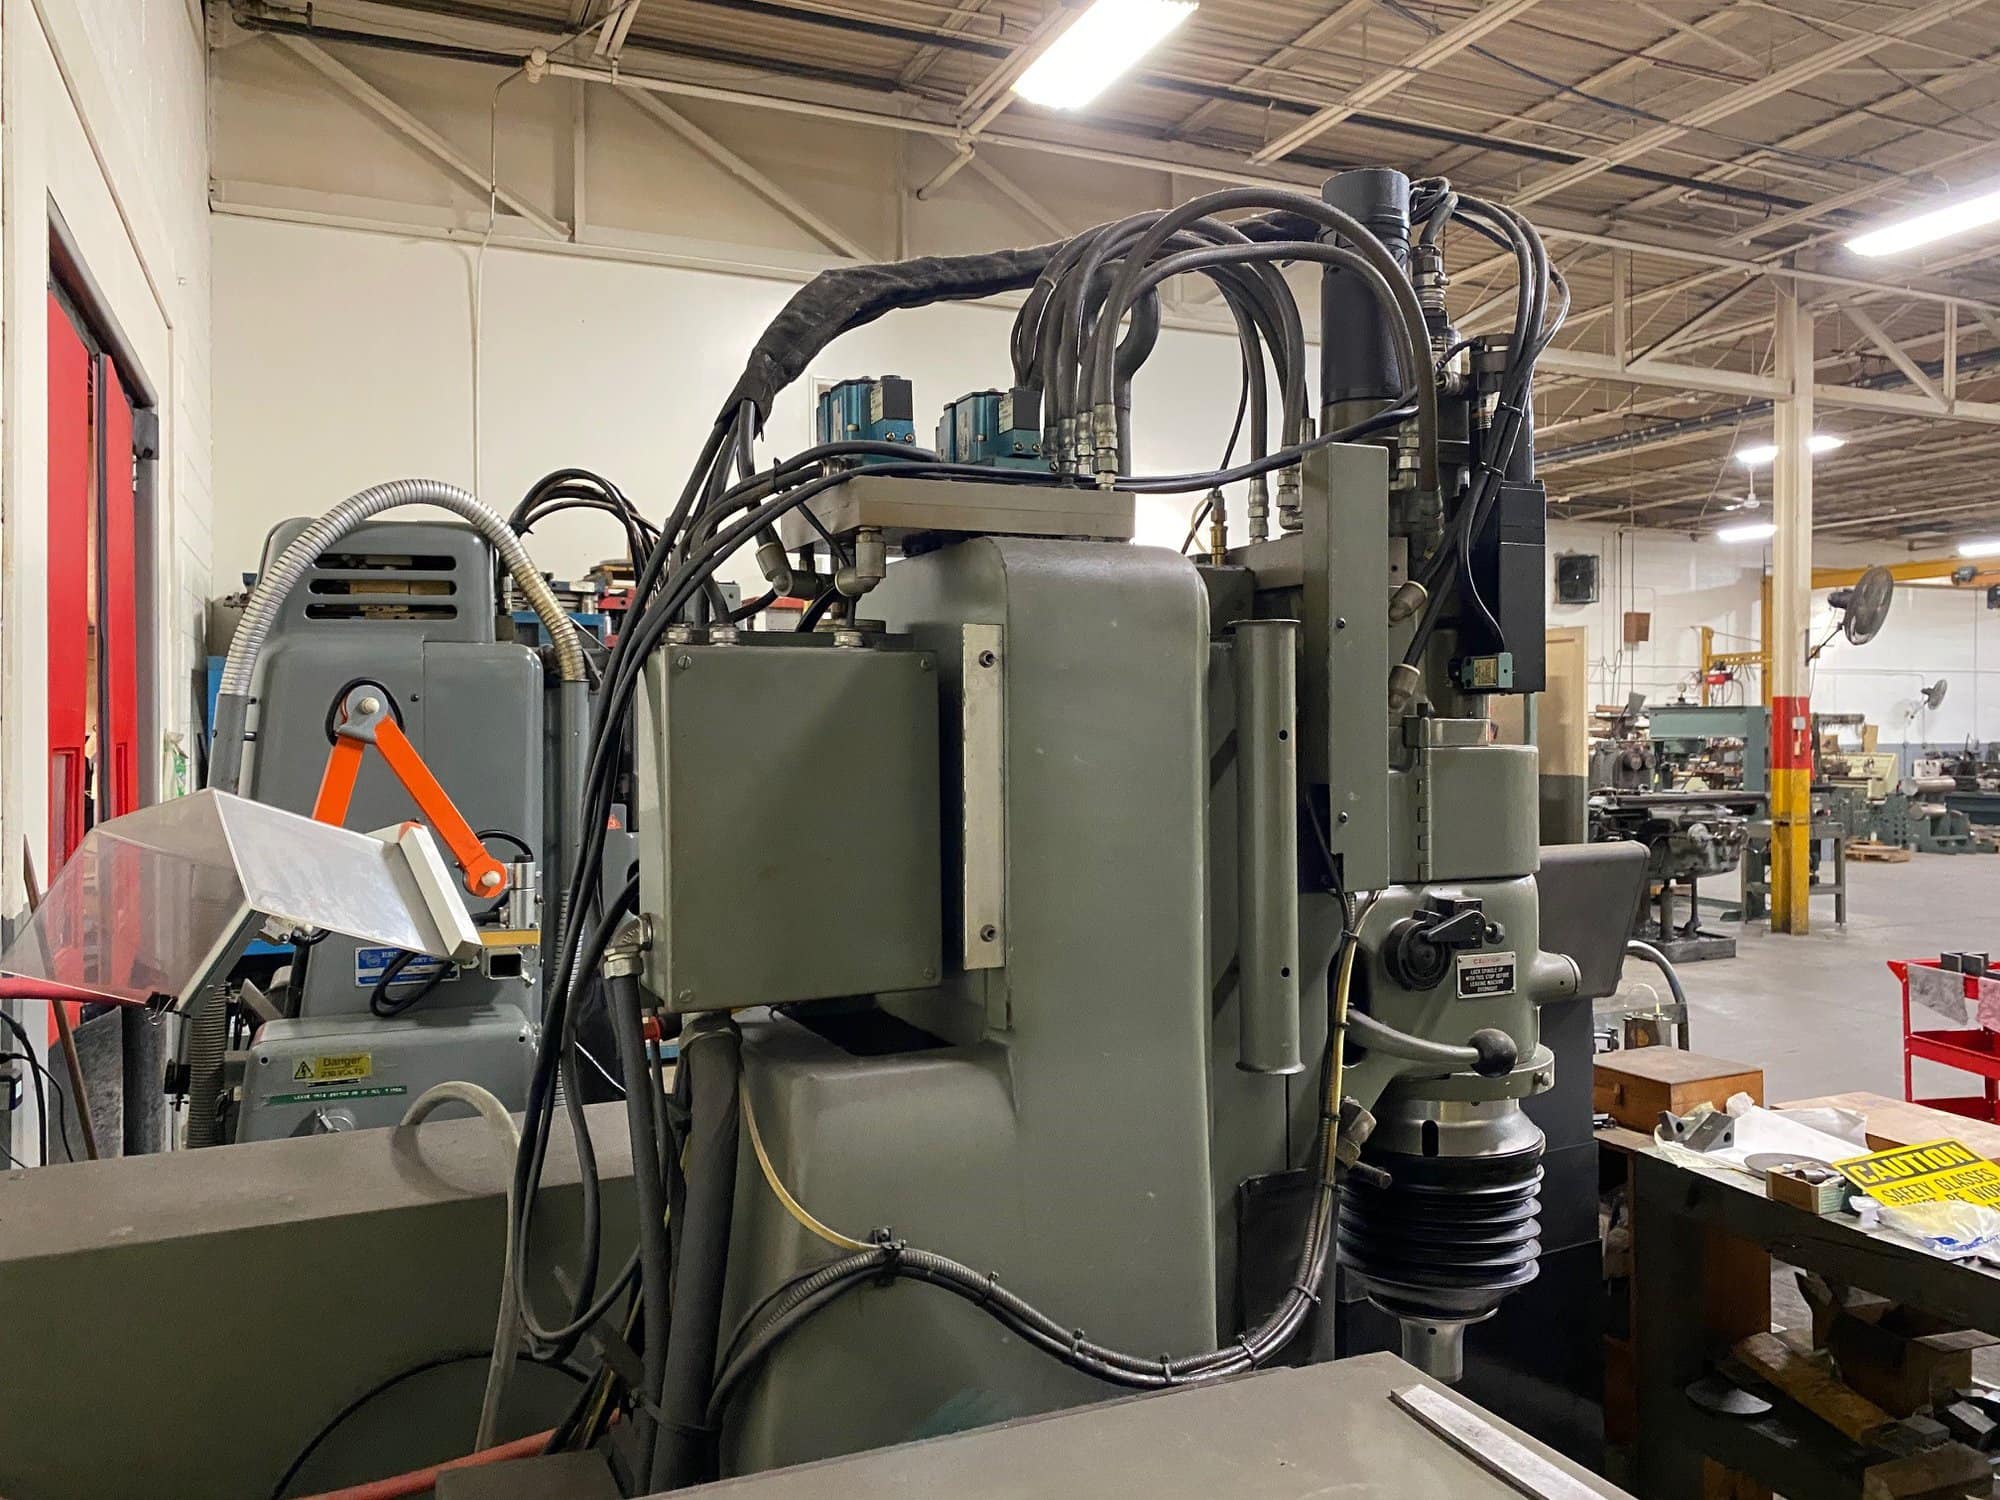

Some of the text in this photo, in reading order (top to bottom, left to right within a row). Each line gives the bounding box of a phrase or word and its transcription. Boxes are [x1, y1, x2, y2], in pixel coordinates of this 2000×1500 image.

[1847, 1144, 1975, 1184] CAUTION
[1881, 1181, 1937, 1202] SAFETY
[1934, 1168, 1998, 1191] GLASSES
[1967, 1182, 2000, 1200] WOR
